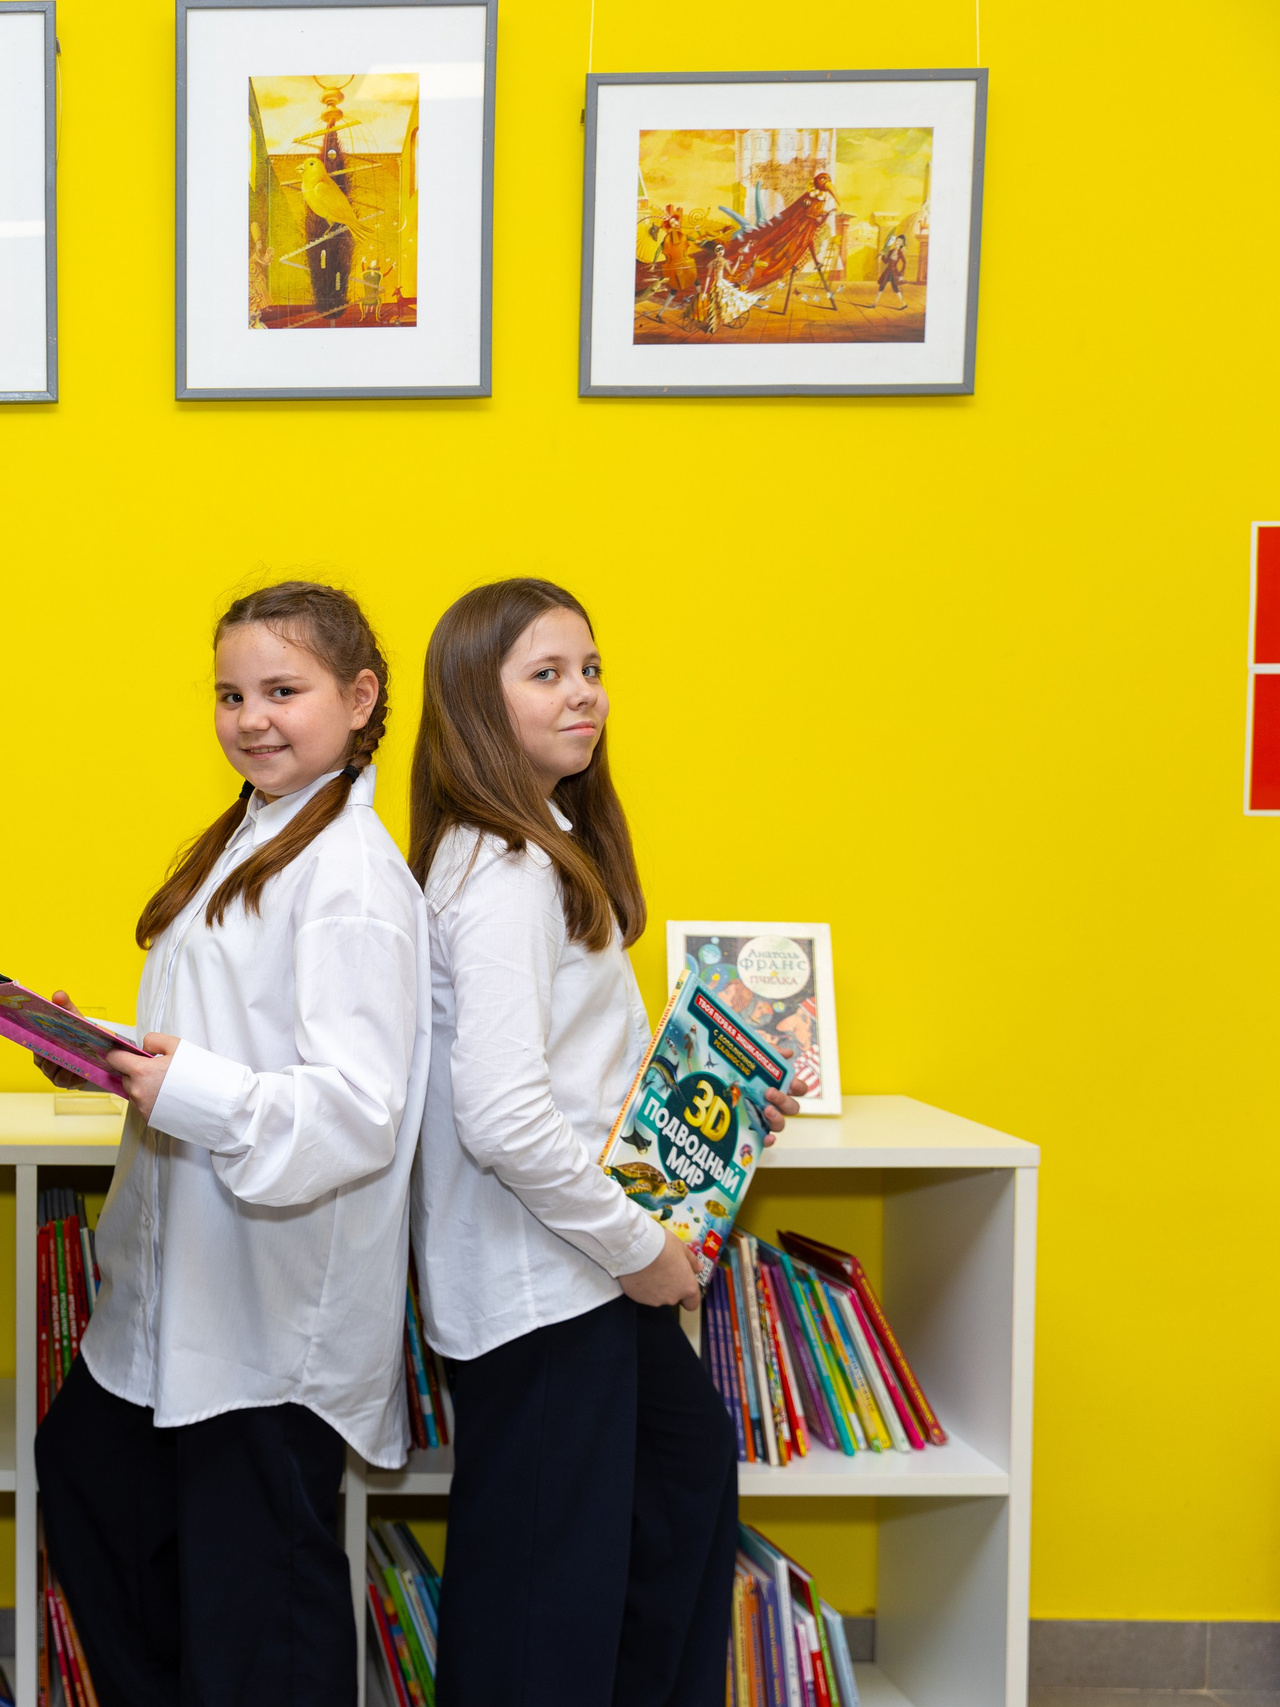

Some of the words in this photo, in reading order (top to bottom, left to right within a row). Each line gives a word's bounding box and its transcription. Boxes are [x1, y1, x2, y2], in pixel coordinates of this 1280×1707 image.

[739, 958, 806, 972] ФРАНС
[698, 998, 714, 1018] ТВОЯ
[712, 1010, 736, 1037] ПЕРВАЯ
[736, 1032, 781, 1080] ЭНЦИКЛОПЕДИЯ
[713, 1040, 752, 1076] РЕАЛЬНОСТЬЮ
[718, 1033, 756, 1072] ДОПОЛНЕННОЙ
[684, 1080, 731, 1142] 3D
[644, 1094, 744, 1194] ПОДВОДНЫЙ
[666, 1144, 705, 1188] МИР
